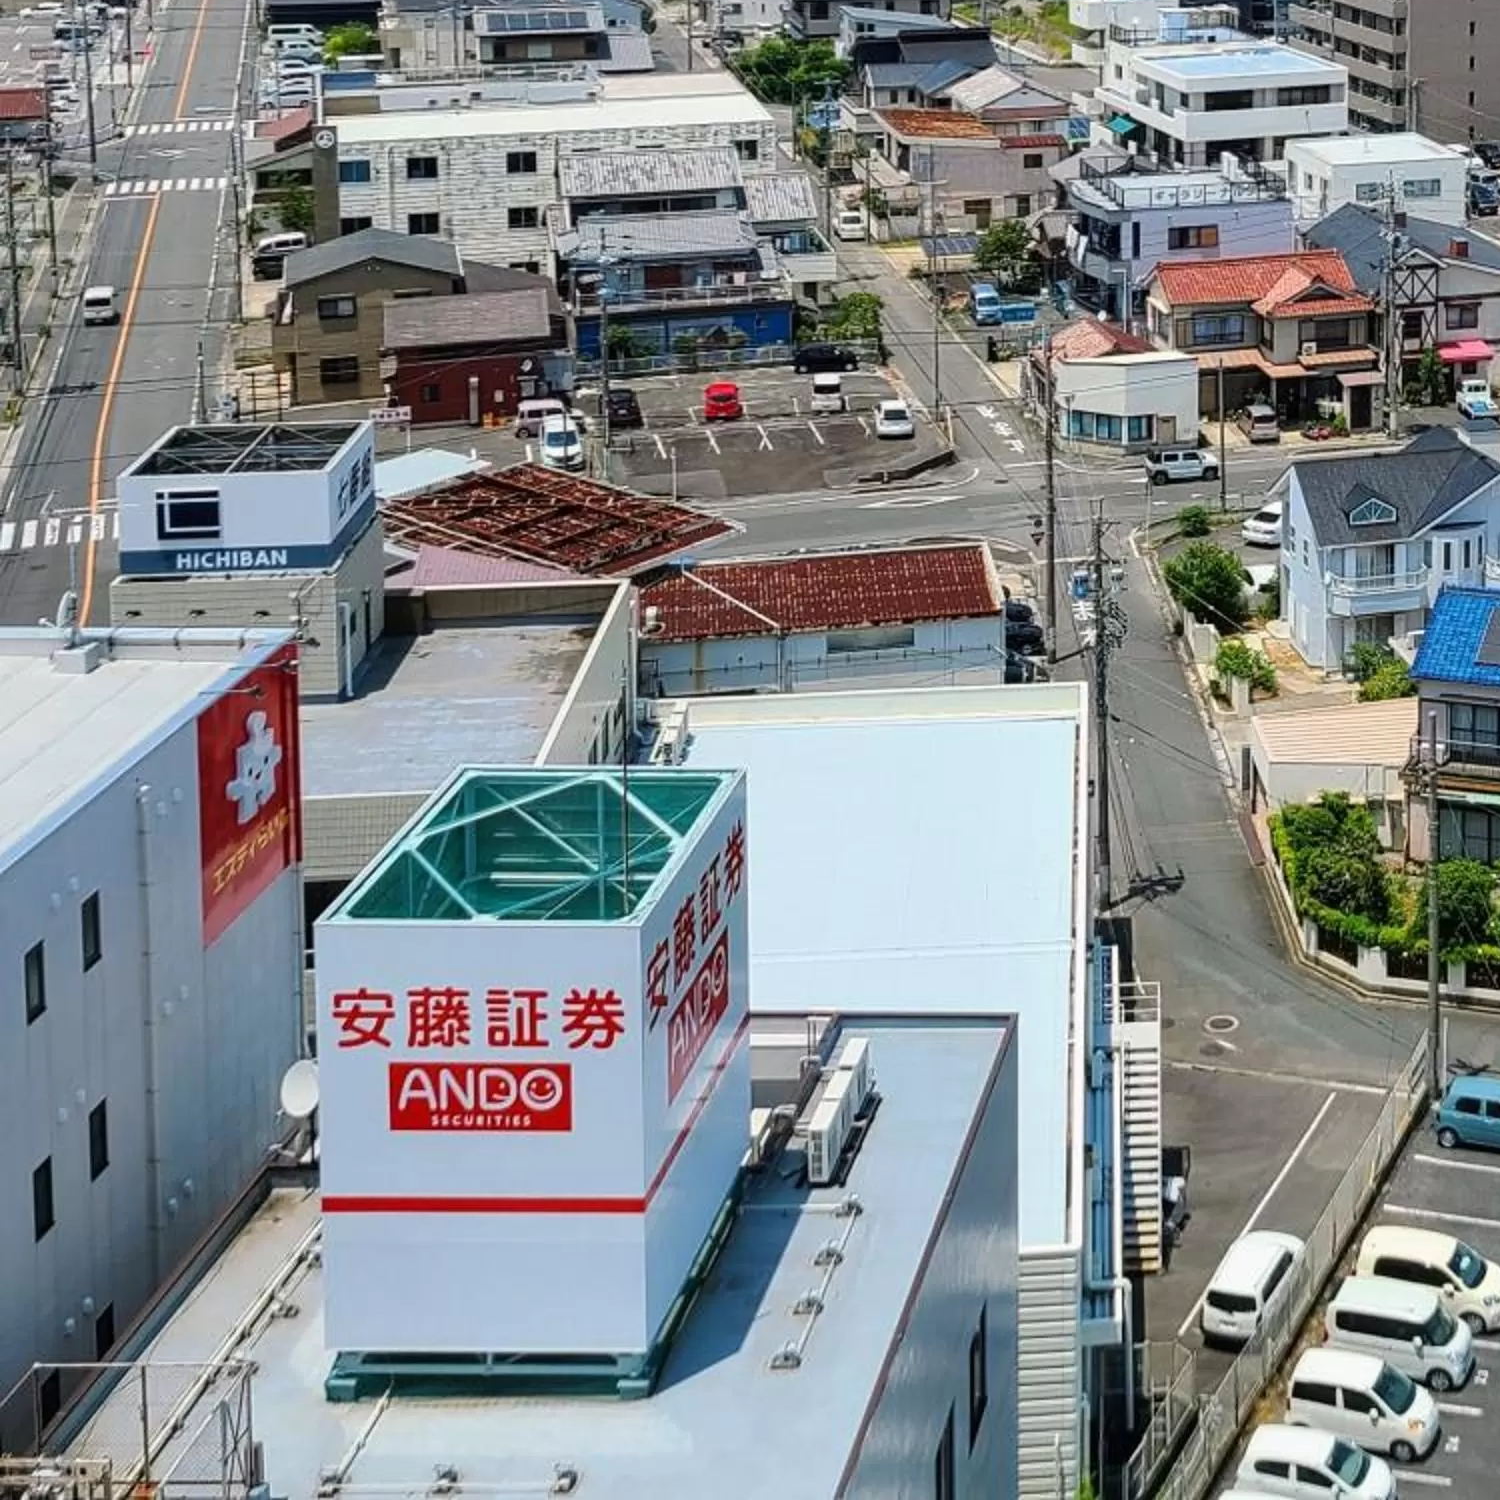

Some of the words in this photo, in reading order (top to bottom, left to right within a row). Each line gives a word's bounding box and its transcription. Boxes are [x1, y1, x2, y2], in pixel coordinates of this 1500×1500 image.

[175, 549, 288, 570] HICHIBAN
[645, 817, 745, 1033] 安藤証券
[331, 986, 625, 1050] 安藤証券
[670, 942, 727, 1076] ANDO
[397, 1067, 563, 1112] ANDO
[430, 1114, 532, 1128] SECURITIES
